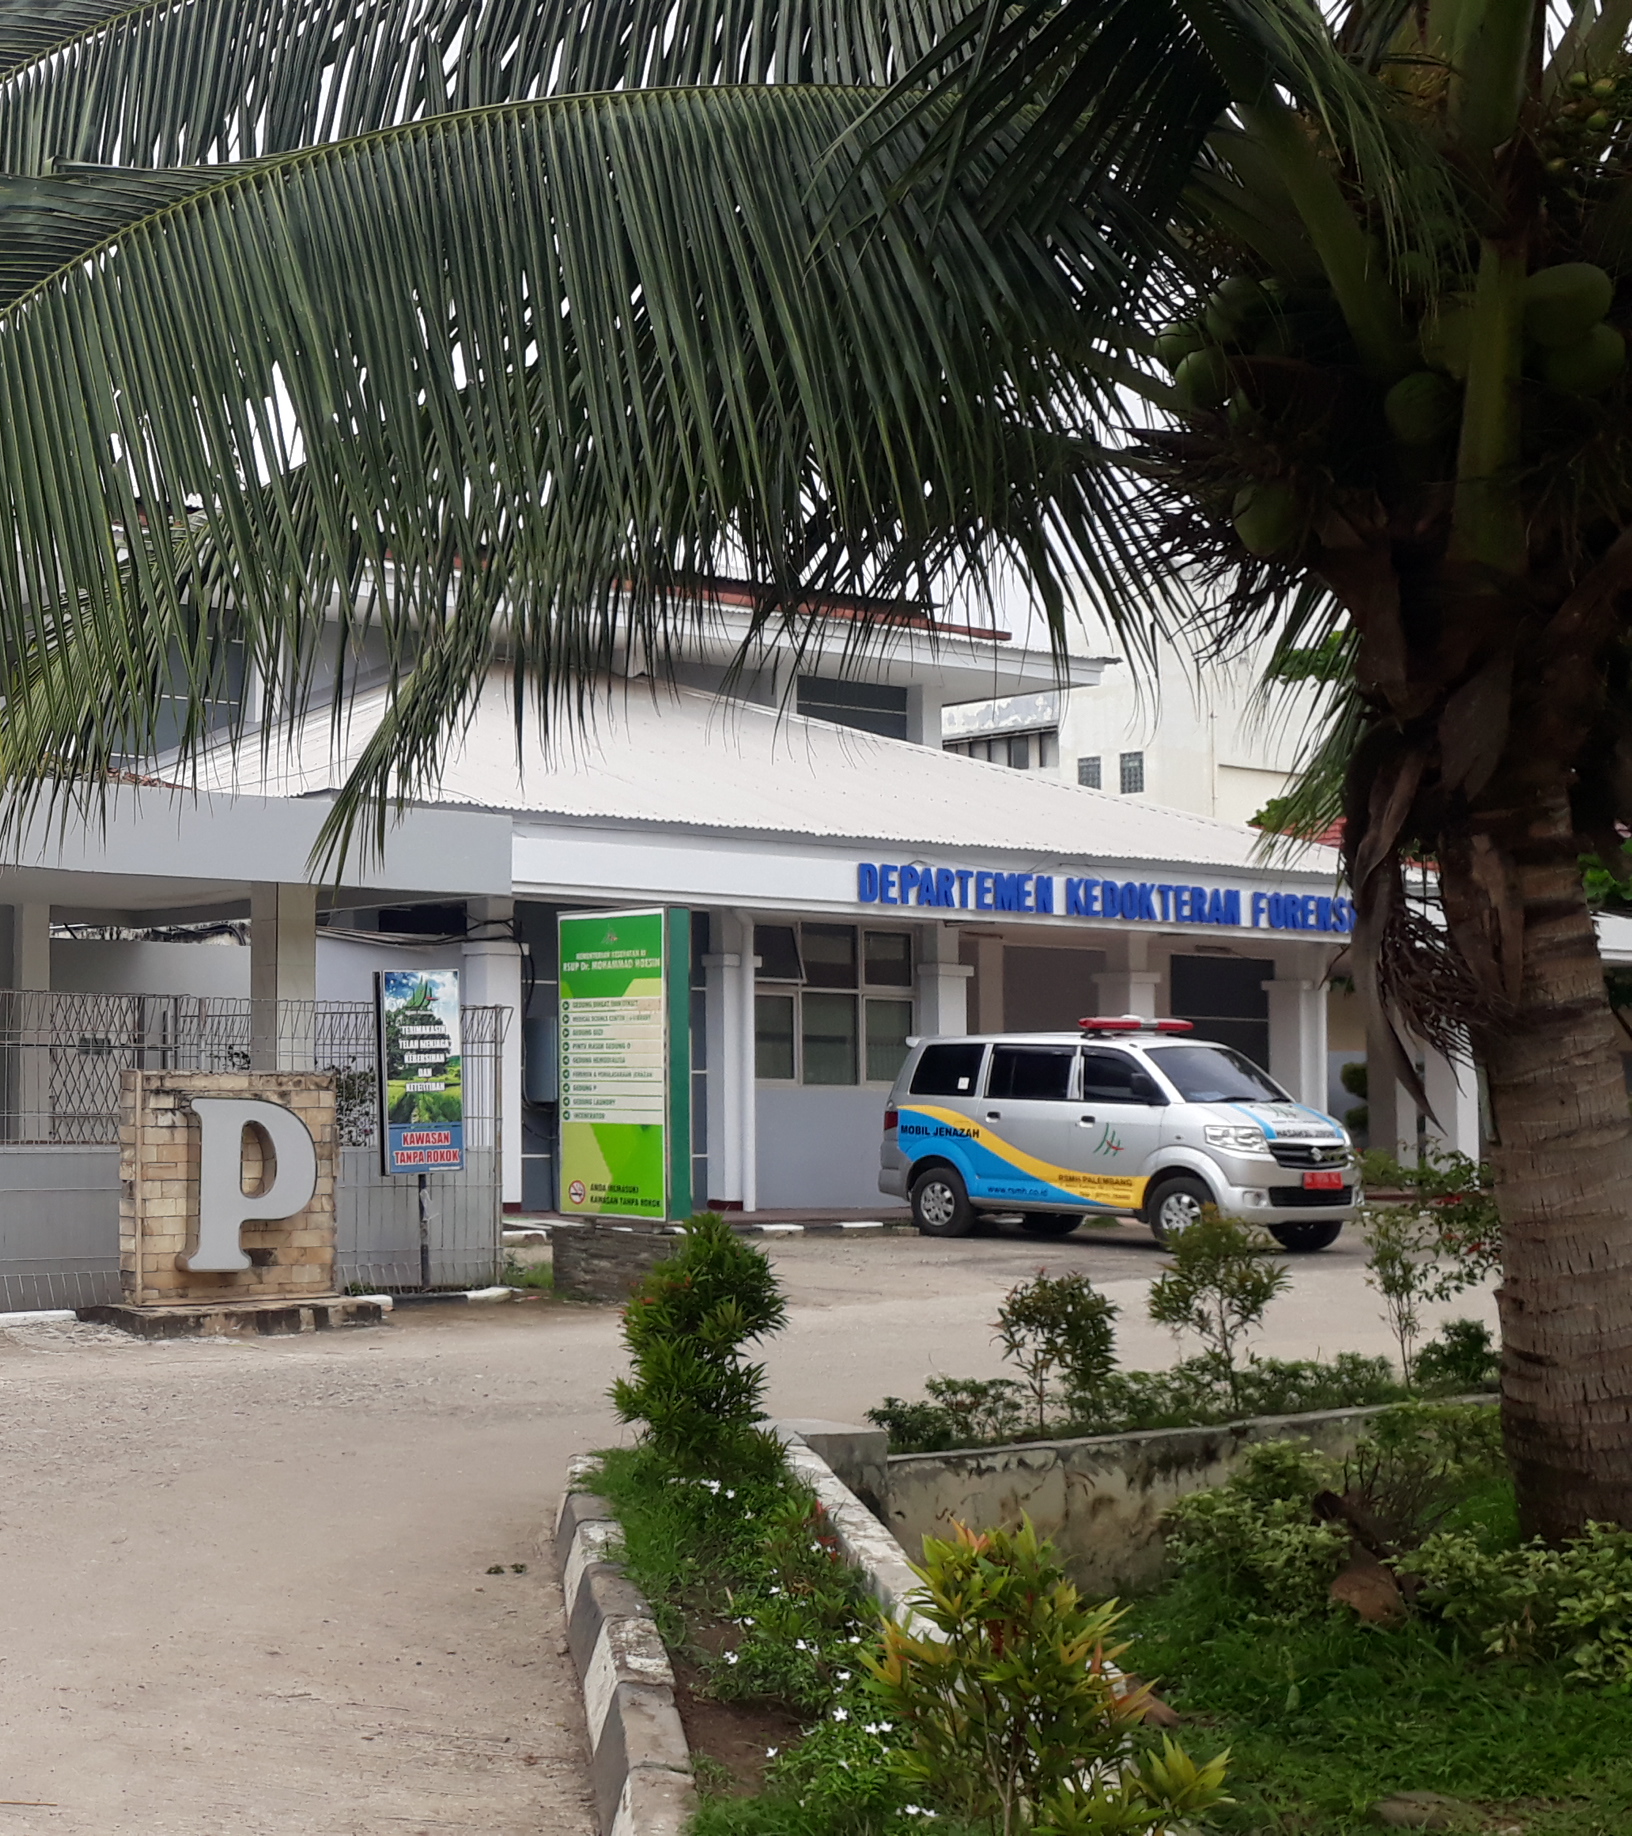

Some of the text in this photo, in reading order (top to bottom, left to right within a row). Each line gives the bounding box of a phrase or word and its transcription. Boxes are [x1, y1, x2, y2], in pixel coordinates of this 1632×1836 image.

[858, 863, 1054, 914] DEPARTEMEN
[1065, 877, 1240, 926] KEDOKTERAN
[562, 962, 580, 971] RSUP
[901, 1125, 980, 1138] MOBIL JENAZAH
[402, 1131, 450, 1146] KAWASAN
[394, 1149, 460, 1165] TANPA ROKOK
[188, 1097, 317, 1271] P
[590, 1183, 606, 1191] ANDA
[1082, 1175, 1133, 1186] PALEMBANG
[590, 1196, 618, 1204] KAWASAN
[619, 1197, 639, 1206] TANPA
